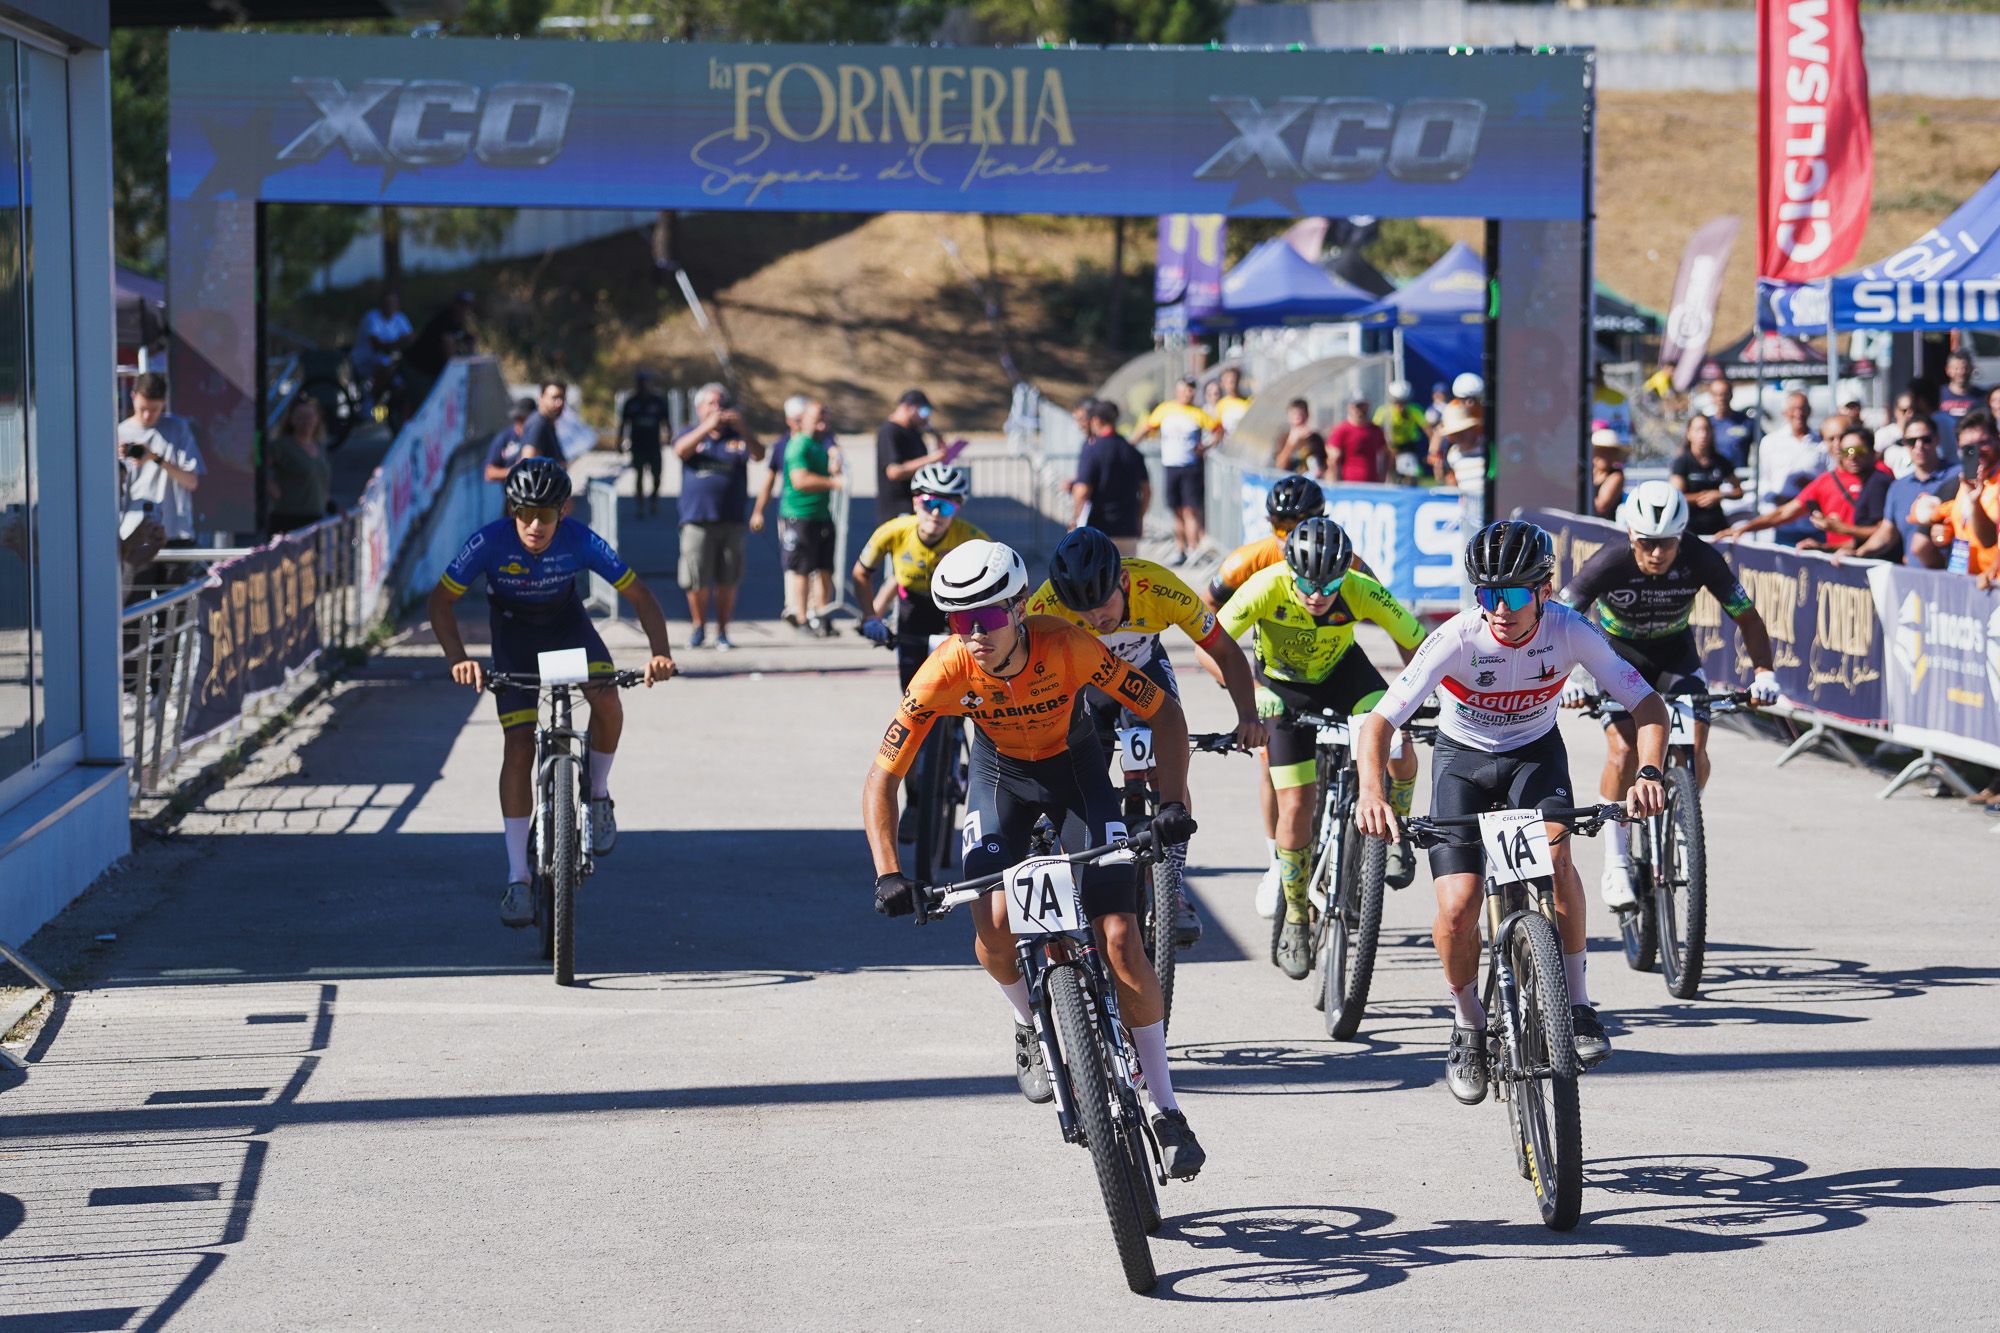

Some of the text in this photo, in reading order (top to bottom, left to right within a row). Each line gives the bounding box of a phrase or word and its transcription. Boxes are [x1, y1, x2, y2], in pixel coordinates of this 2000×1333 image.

[709, 56, 732, 90] la
[733, 61, 1076, 146] FORNERIA
[277, 77, 573, 167] XCO
[1193, 95, 1488, 182] XCO
[1151, 584, 1192, 606] spump
[1369, 591, 1403, 620] mr.print
[1536, 645, 1554, 655] PACTO
[1040, 682, 1060, 693] PACTO
[962, 694, 1070, 719] BILABIKERS
[1502, 814, 1535, 822] CICLISMO
[1497, 825, 1537, 869] 1A
[1016, 872, 1063, 923] 7A
